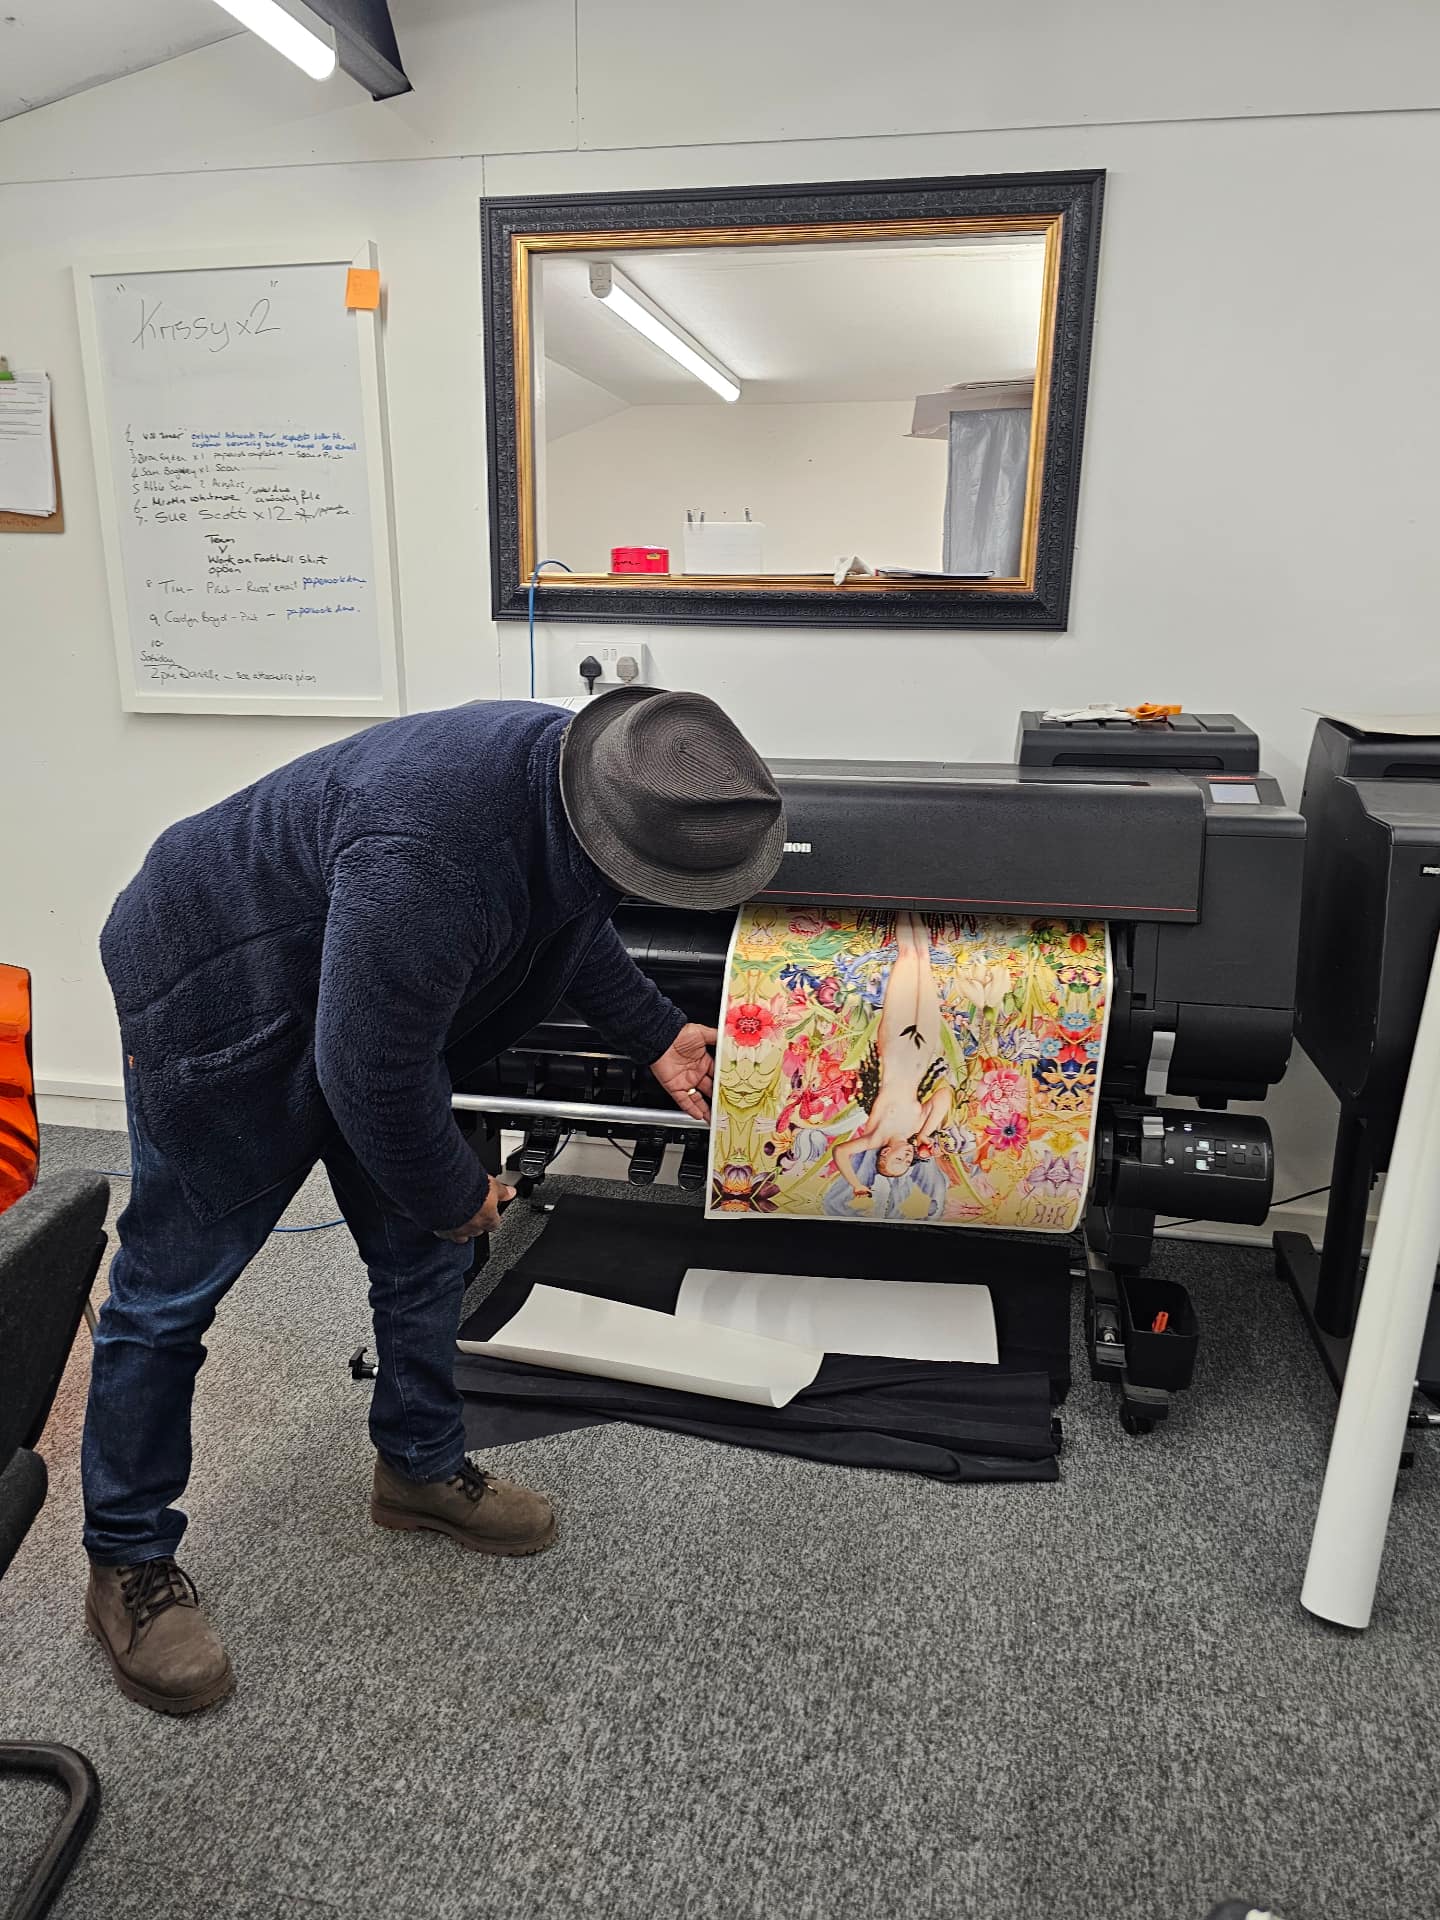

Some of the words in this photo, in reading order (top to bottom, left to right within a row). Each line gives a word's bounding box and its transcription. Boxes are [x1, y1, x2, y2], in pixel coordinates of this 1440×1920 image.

[154, 511, 188, 524] Sue
[197, 505, 248, 521] Scott
[782, 841, 812, 853] non
